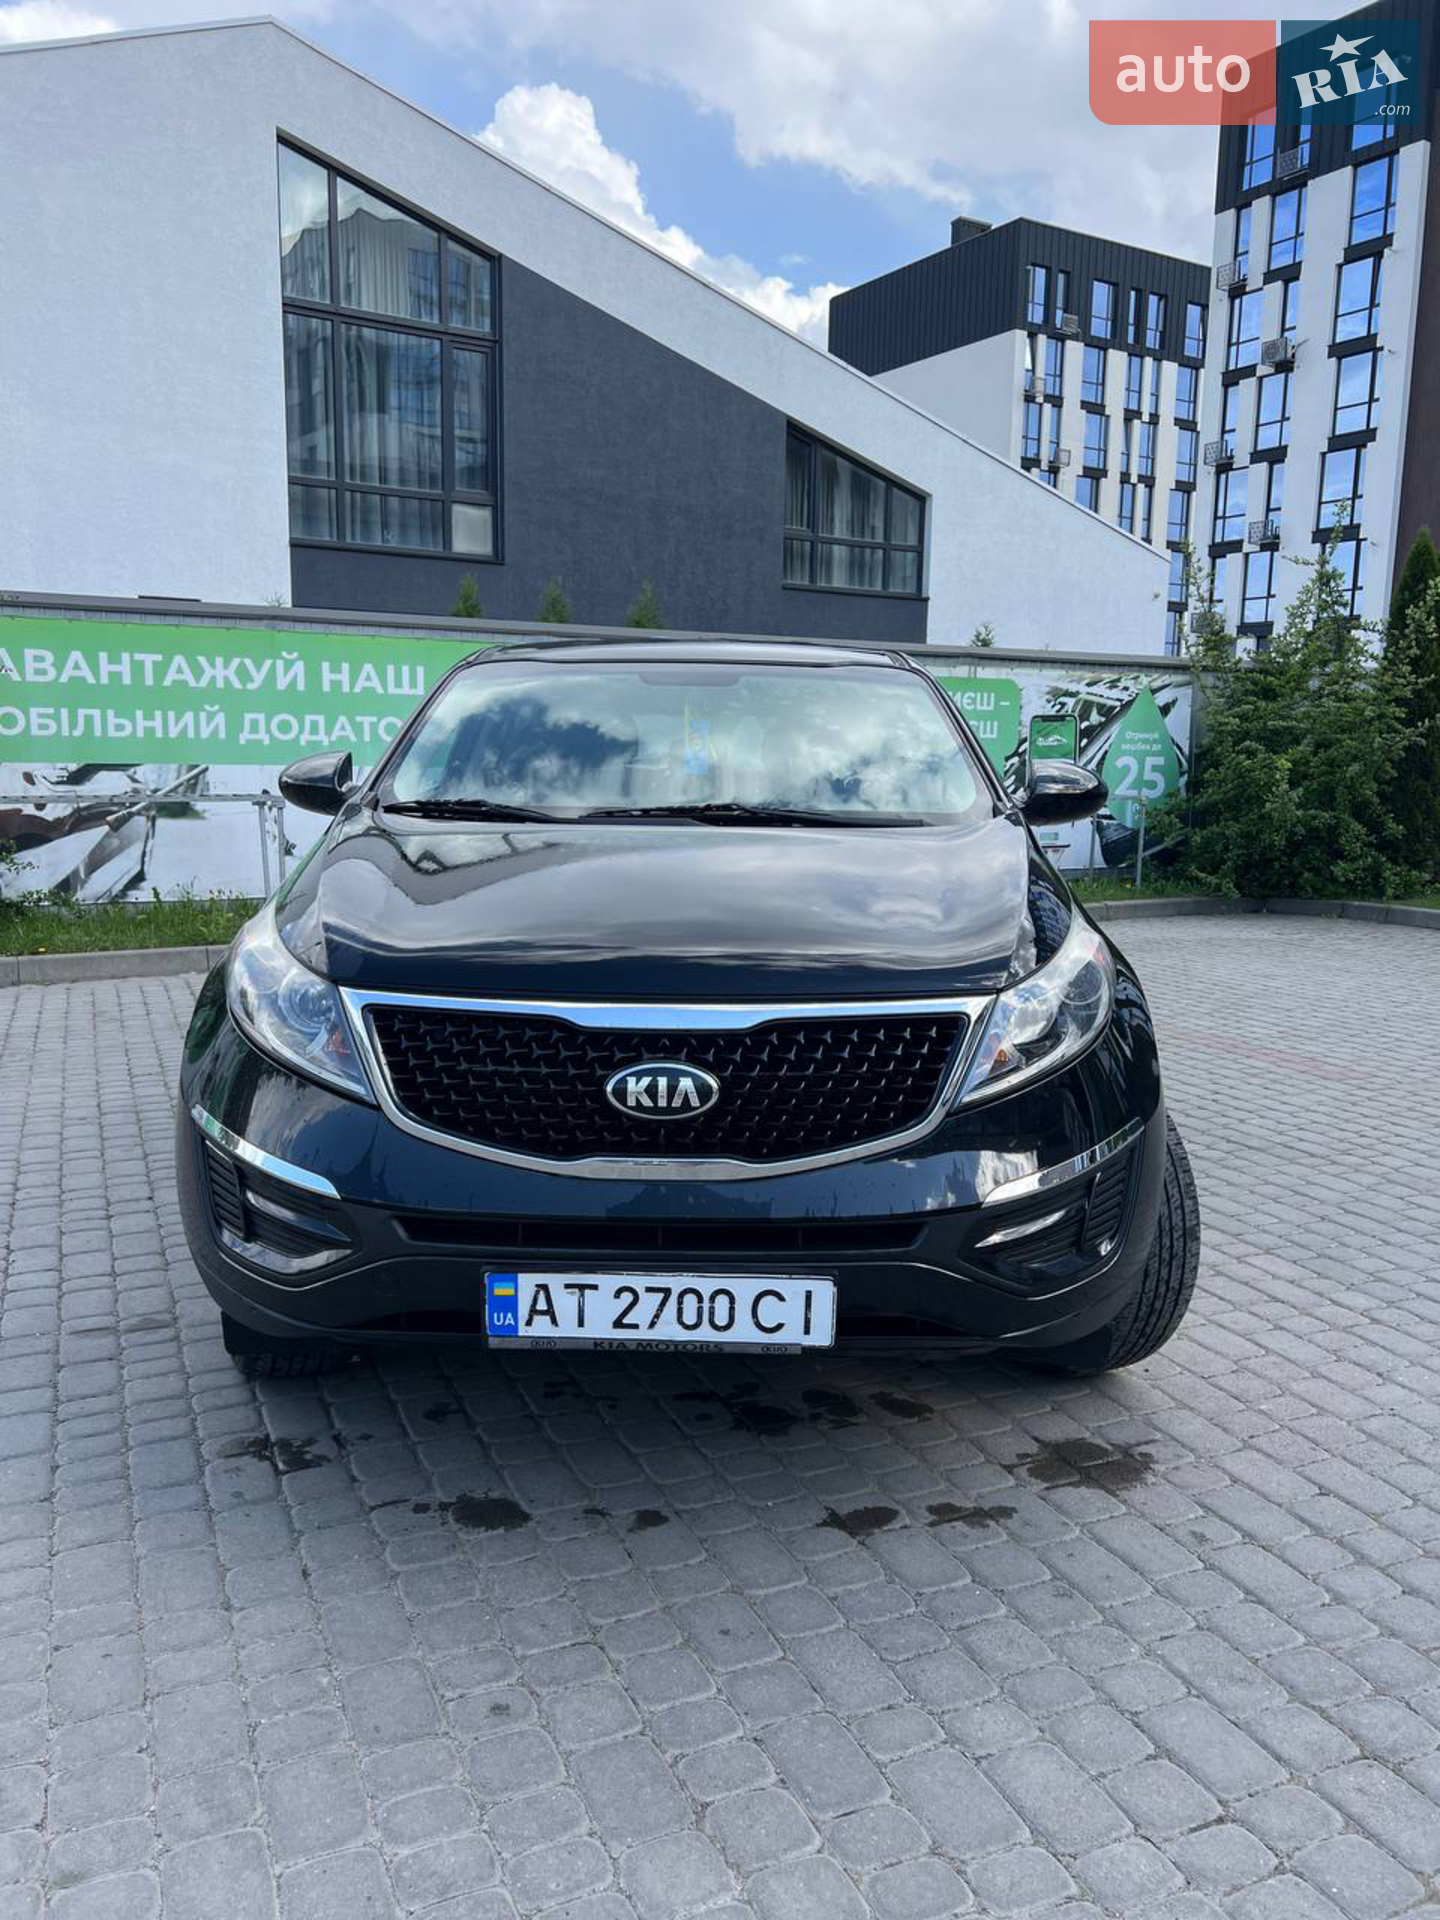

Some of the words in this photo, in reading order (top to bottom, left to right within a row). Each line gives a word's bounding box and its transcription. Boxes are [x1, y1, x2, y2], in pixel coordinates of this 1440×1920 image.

[322, 660, 424, 696] НАШ
[1114, 755, 1165, 799] 25
[625, 1076, 701, 1108] KIA
[494, 1312, 516, 1327] UA
[612, 1285, 736, 1333] 2700
[593, 1341, 627, 1351] KIA
[636, 1342, 723, 1353] MOTORS
